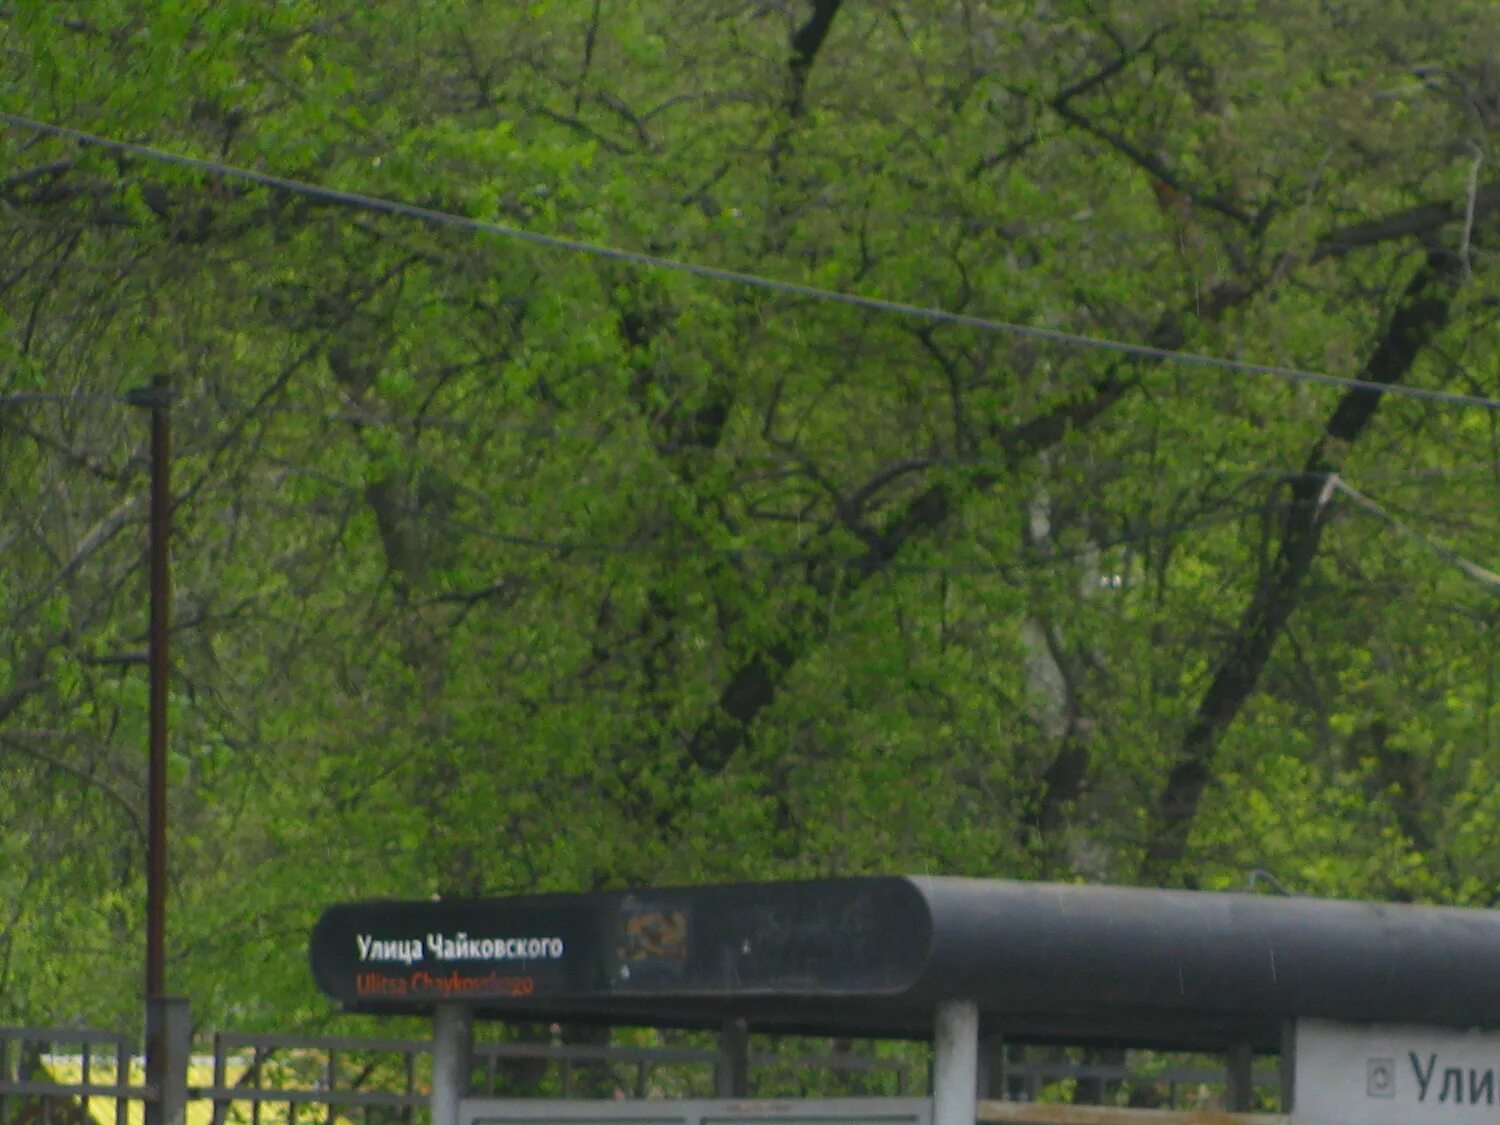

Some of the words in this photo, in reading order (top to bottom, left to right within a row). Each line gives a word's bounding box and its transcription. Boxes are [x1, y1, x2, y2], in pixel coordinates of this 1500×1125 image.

[356, 934, 423, 965] Улица
[426, 931, 564, 960] Чайковского
[356, 972, 407, 996] Ulitsa
